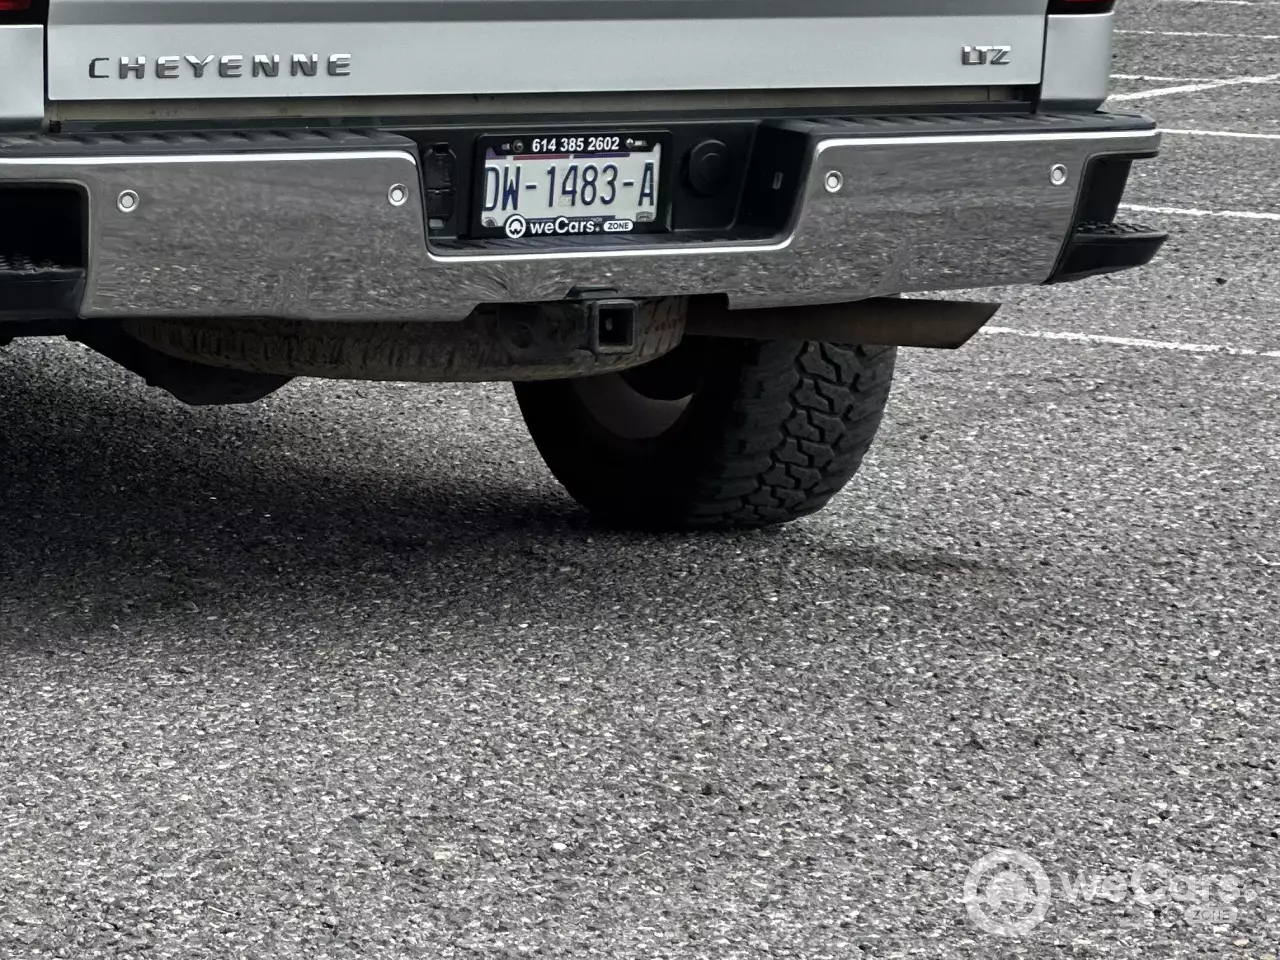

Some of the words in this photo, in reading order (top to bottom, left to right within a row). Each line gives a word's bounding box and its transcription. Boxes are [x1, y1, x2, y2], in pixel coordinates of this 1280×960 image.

[961, 45, 1012, 65] LTZ
[88, 53, 352, 80] CHEYENNE
[532, 138, 557, 152] 614
[560, 138, 584, 151] 385
[587, 136, 619, 151] 2602
[483, 161, 655, 211] DW-1483-A
[607, 221, 630, 230] ZONE
